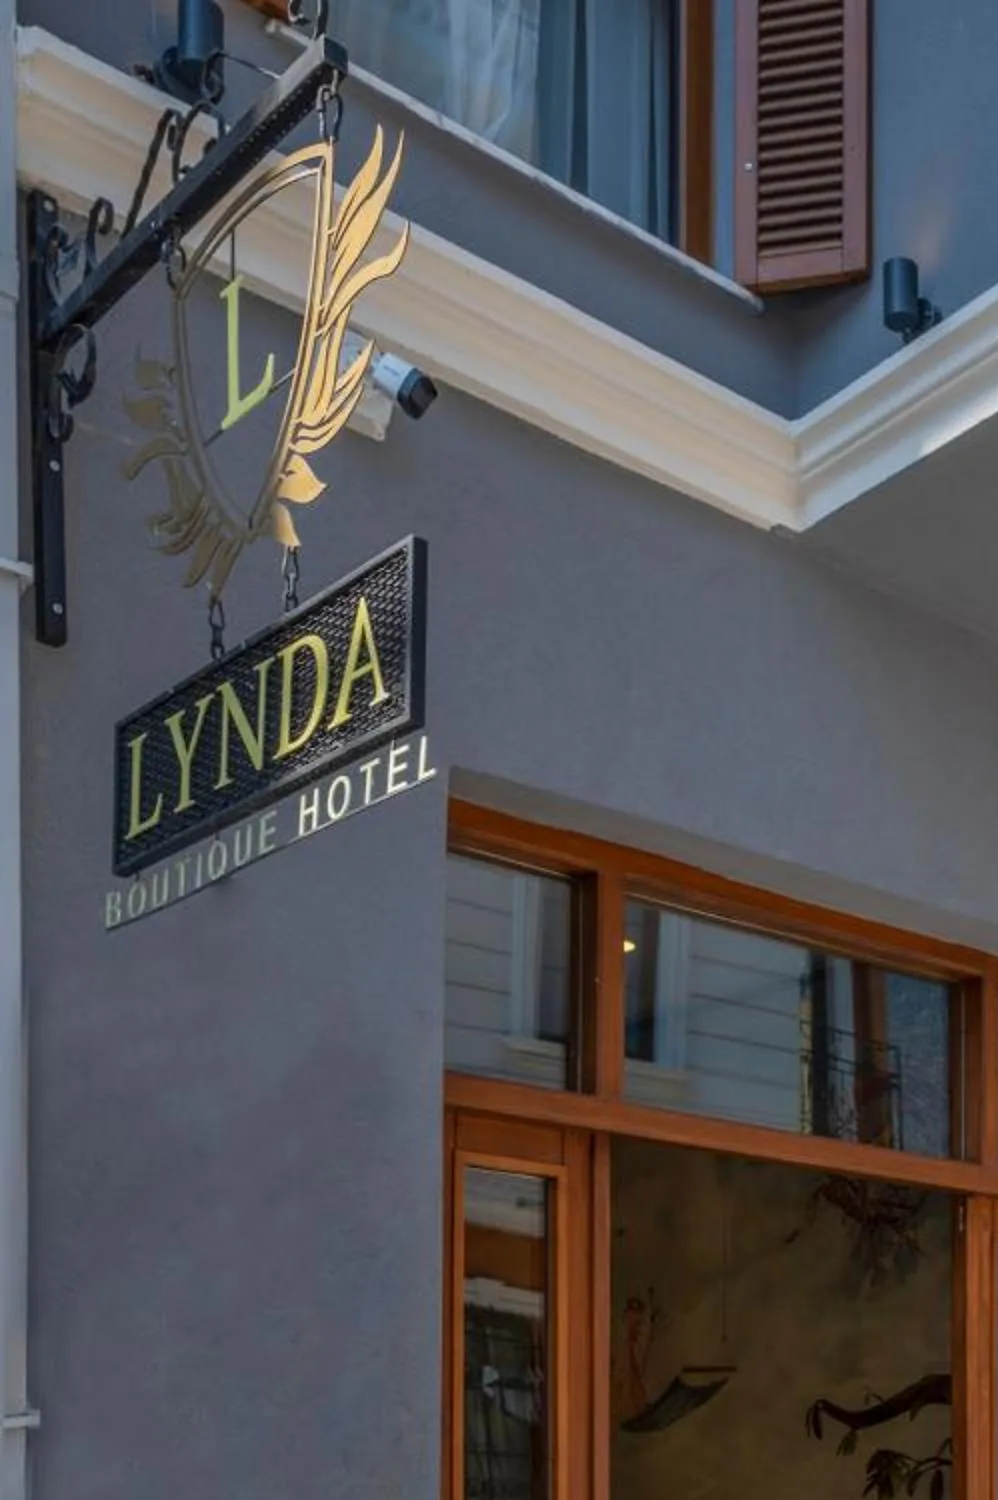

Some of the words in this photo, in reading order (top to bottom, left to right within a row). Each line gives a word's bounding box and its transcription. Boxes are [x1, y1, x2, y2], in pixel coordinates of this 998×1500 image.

[219, 276, 276, 431] L
[124, 596, 390, 841] LYNDA
[104, 809, 278, 929] BOUTIQUE
[298, 735, 437, 838] HOTEL
